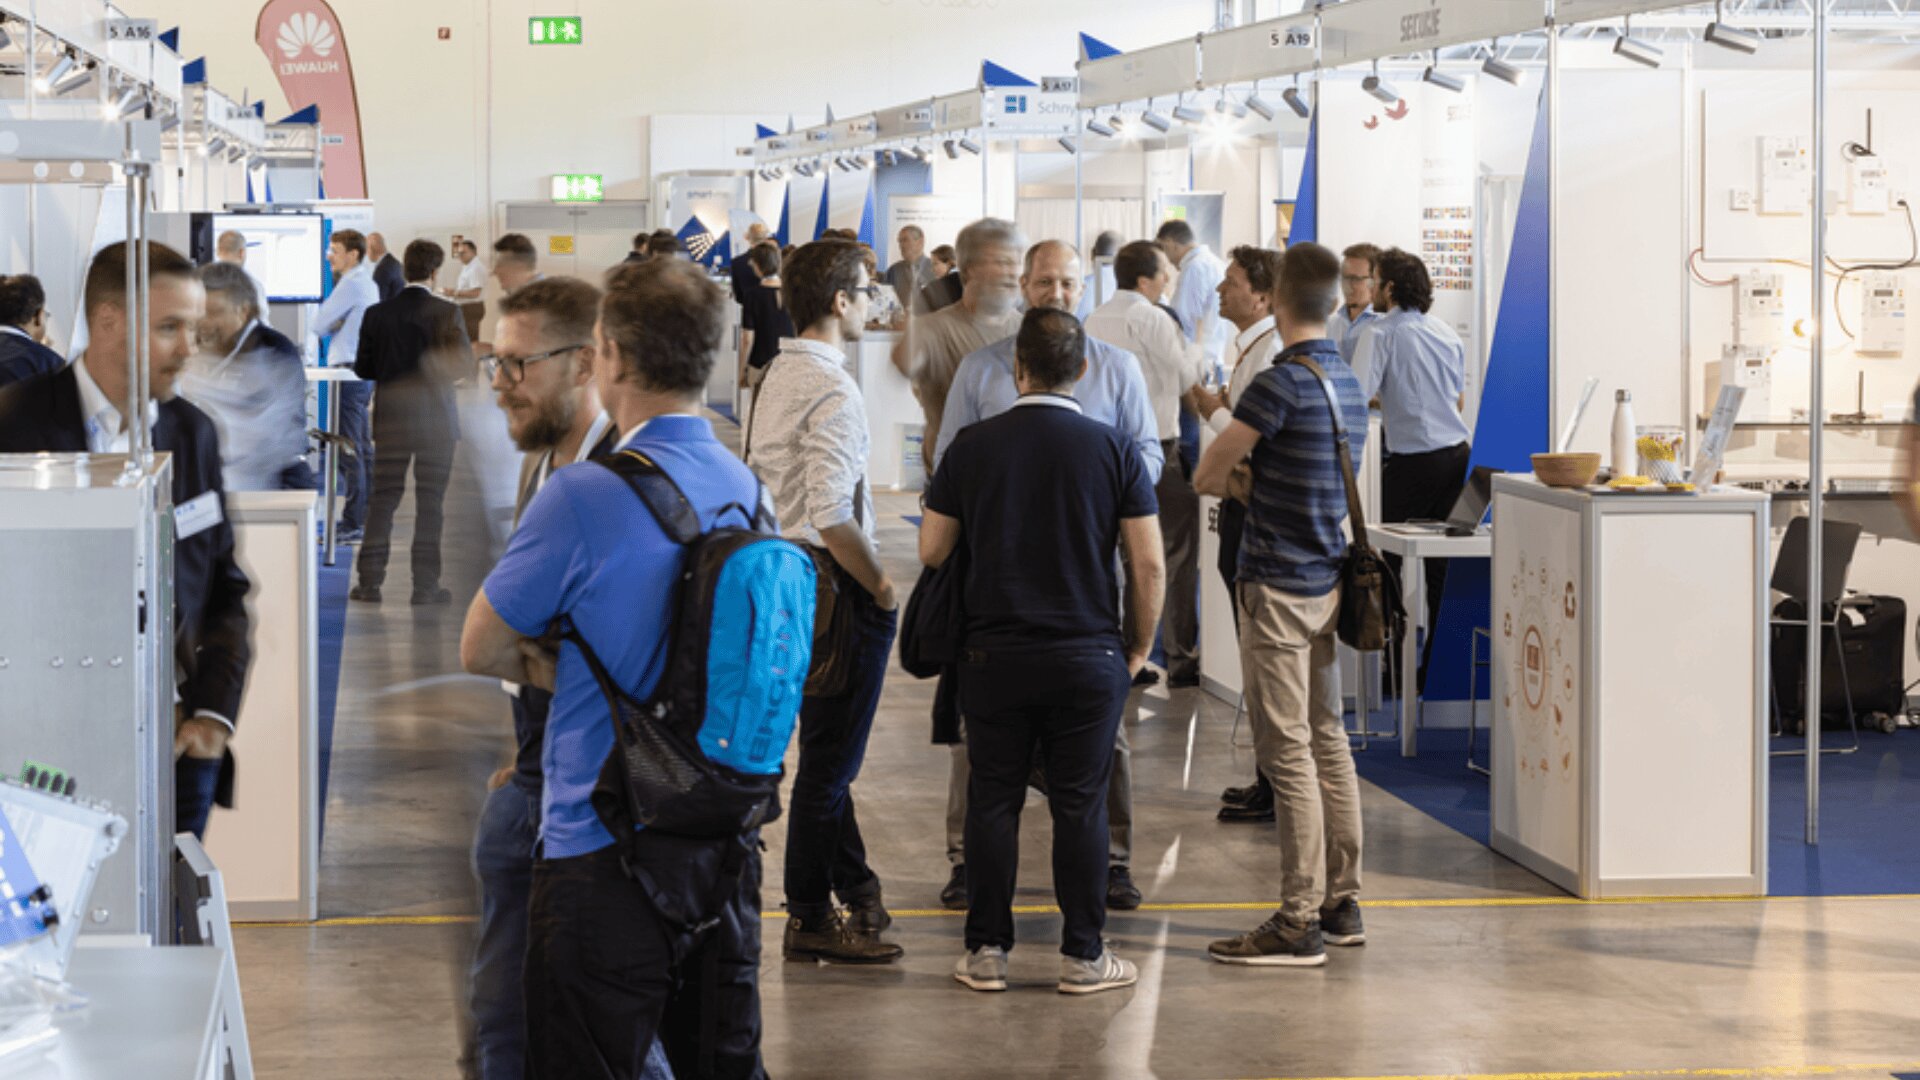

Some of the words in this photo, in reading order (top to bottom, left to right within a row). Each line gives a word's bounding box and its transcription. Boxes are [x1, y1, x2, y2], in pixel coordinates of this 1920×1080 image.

[125, 26, 151, 39] A16
[1271, 33, 1279, 46] S
[1285, 33, 1311, 46] A19
